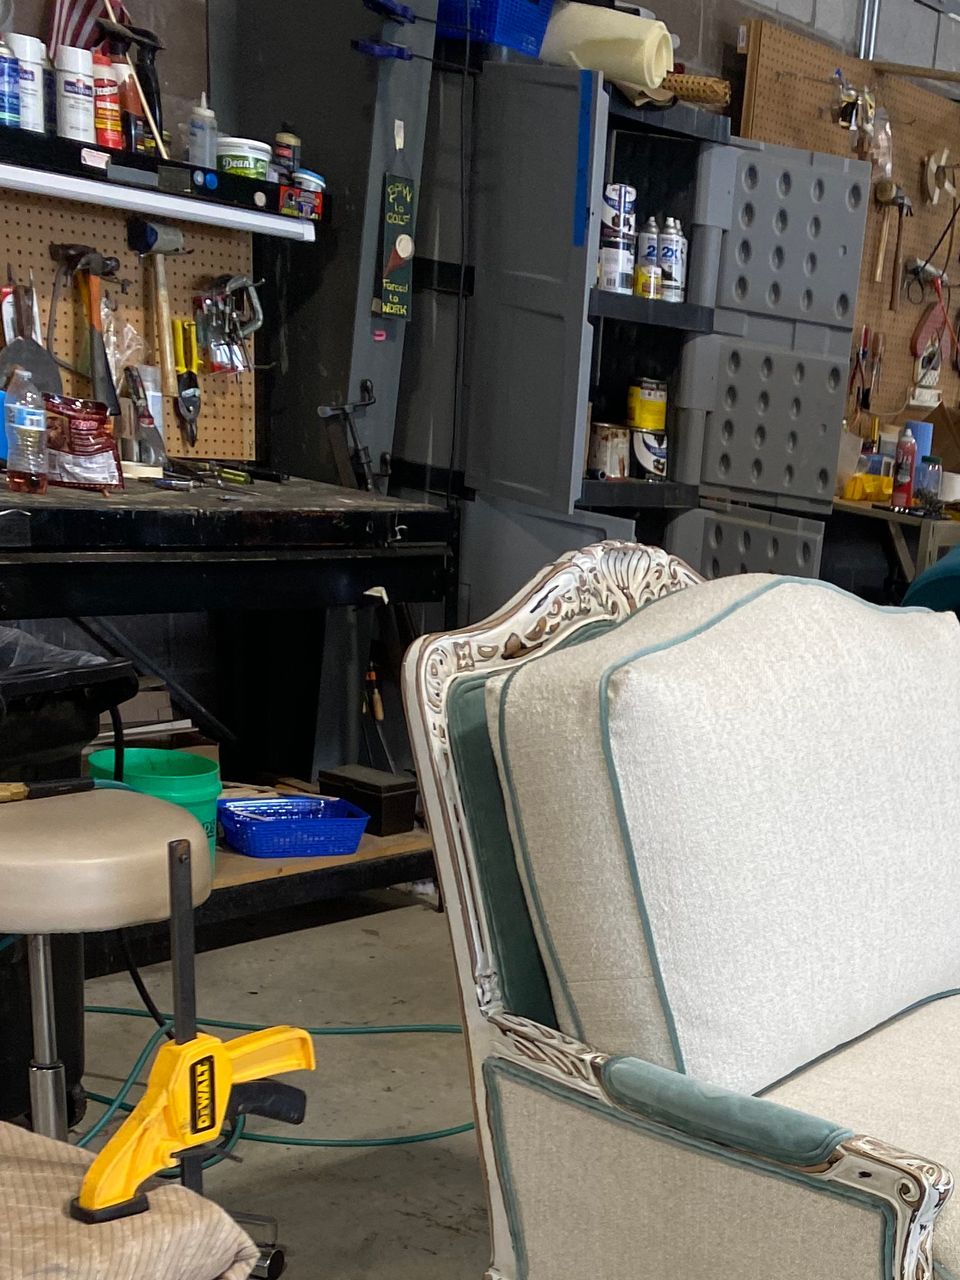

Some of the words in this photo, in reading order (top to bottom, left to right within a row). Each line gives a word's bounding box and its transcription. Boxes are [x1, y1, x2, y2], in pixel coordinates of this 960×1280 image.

[382, 279, 409, 293] Forced
[389, 293, 399, 303] to
[382, 302, 408, 316] WORK
